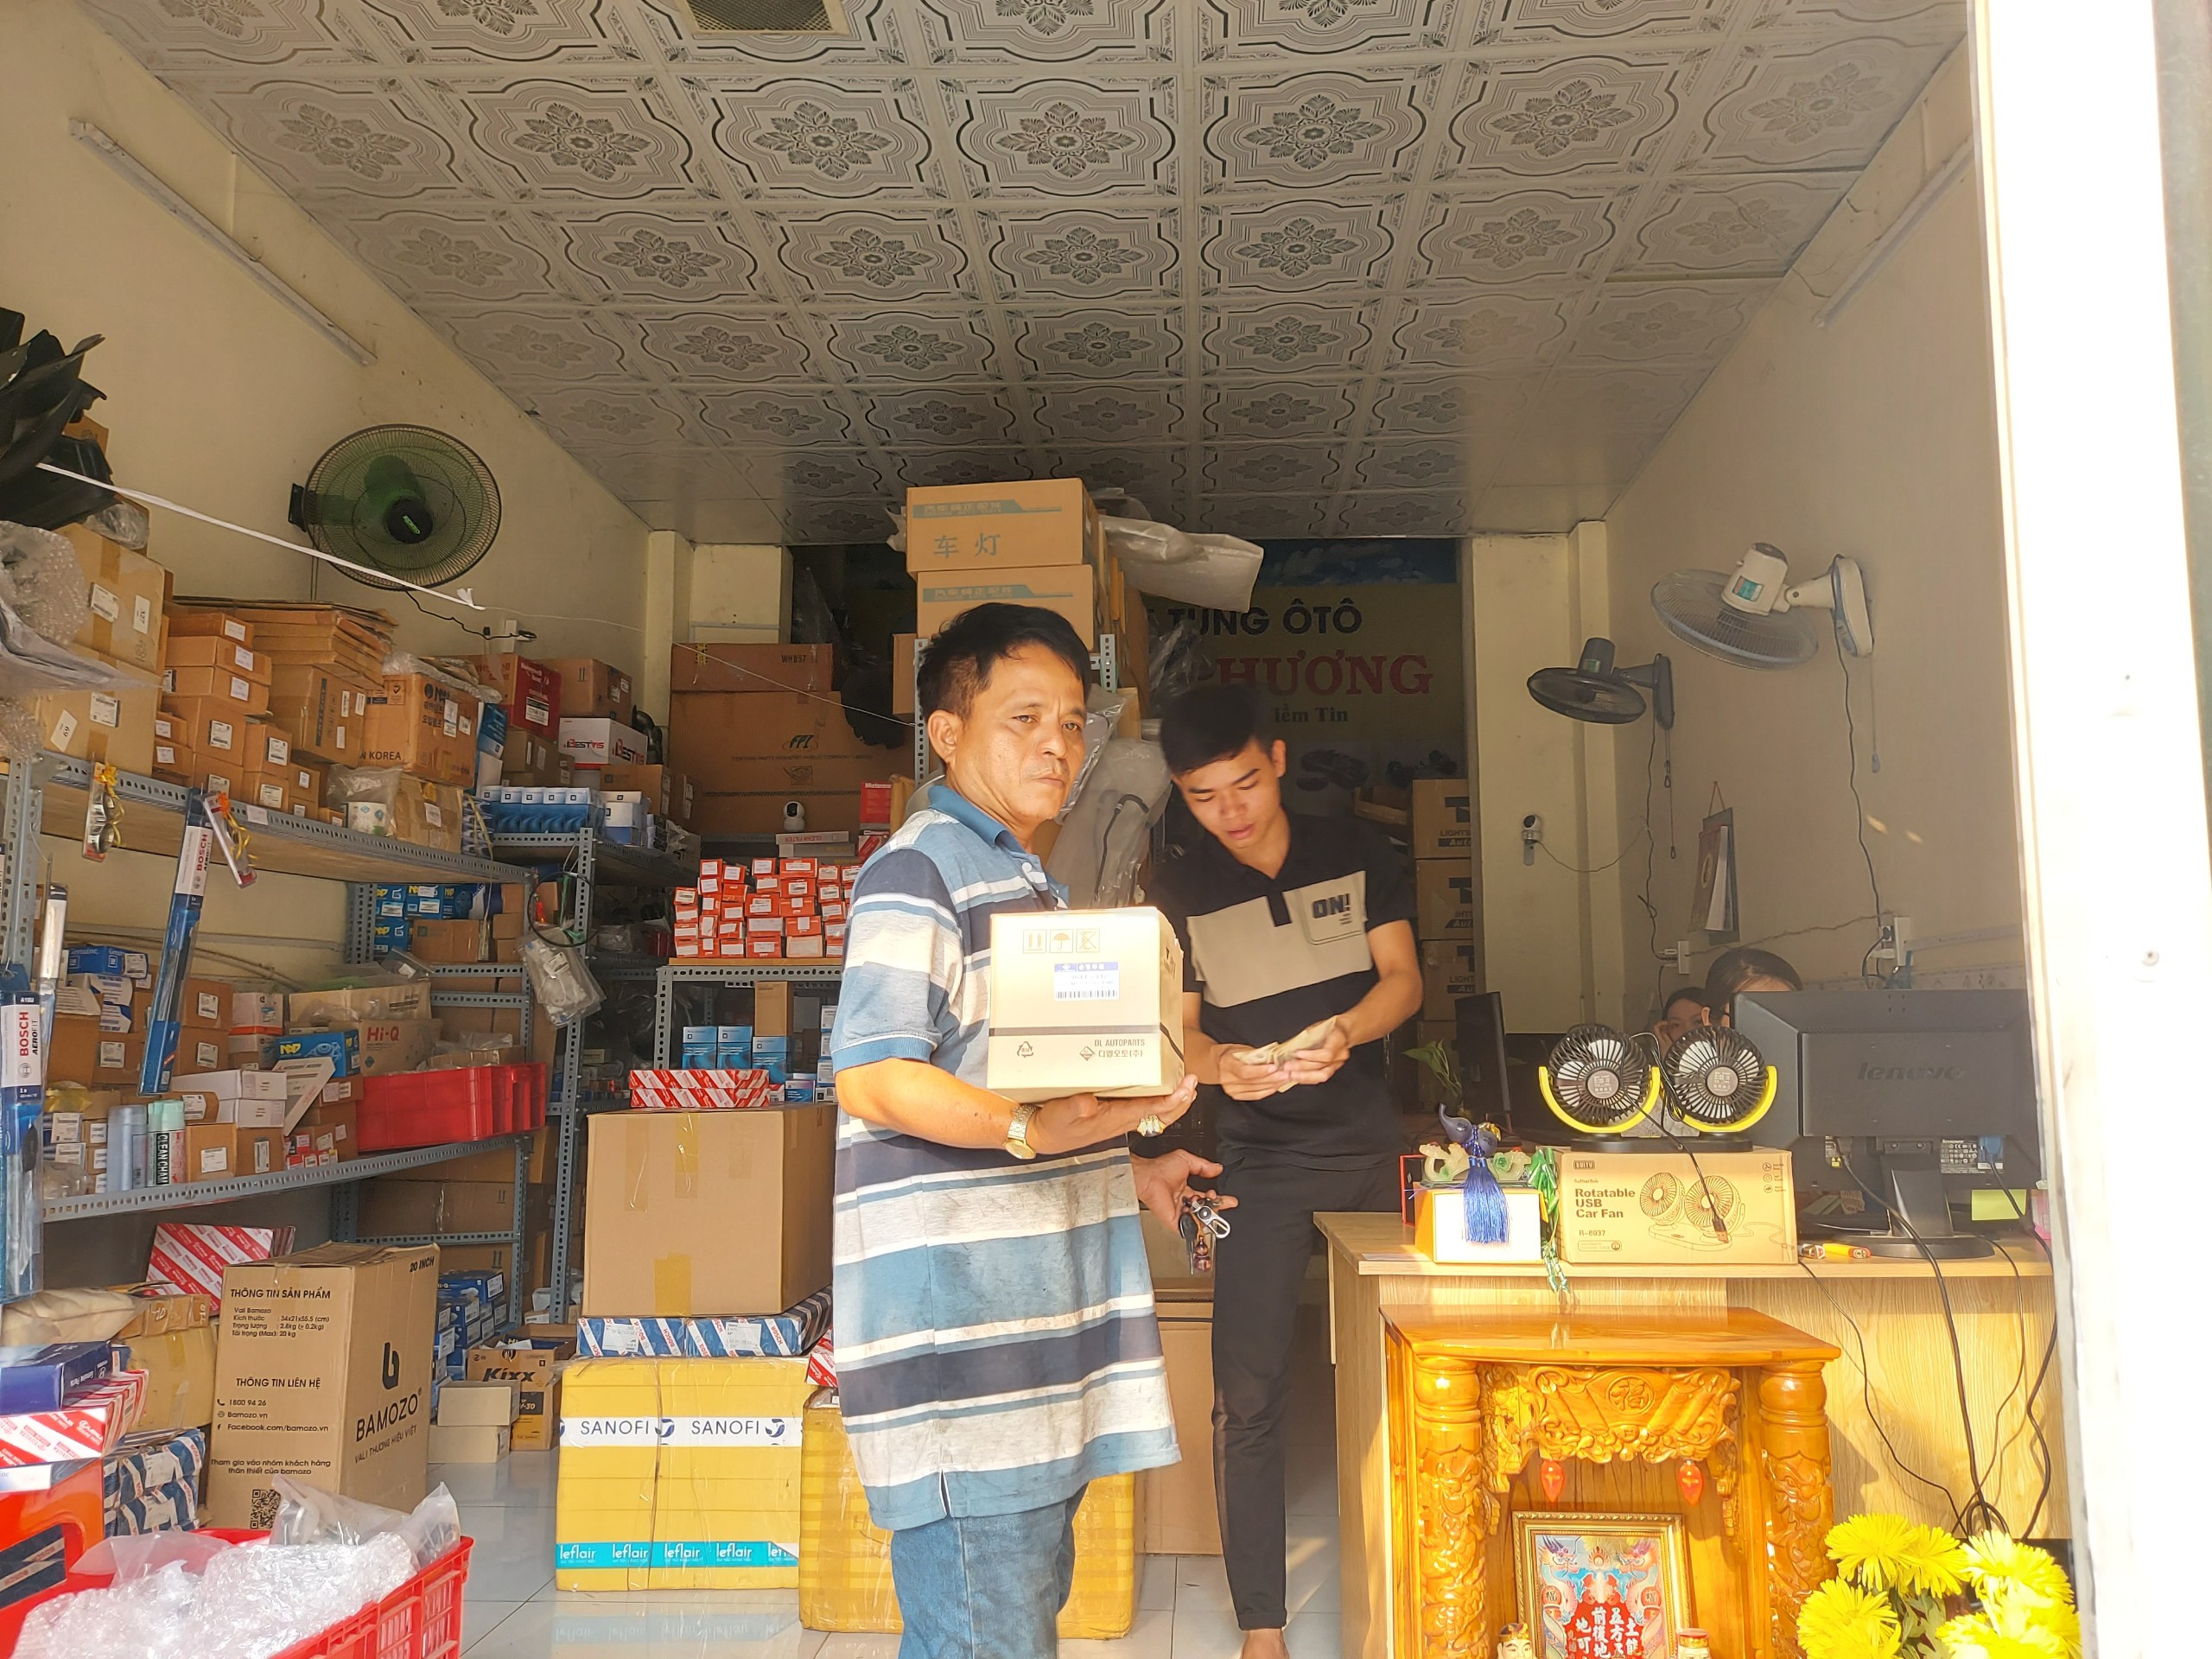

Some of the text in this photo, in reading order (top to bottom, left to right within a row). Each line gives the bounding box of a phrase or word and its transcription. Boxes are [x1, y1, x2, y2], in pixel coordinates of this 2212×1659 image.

[933, 533, 1001, 558] 车灯
[1282, 597, 1363, 635] ÔTÔ
[1215, 649, 1435, 695] HƯƠNG
[1274, 703, 1349, 723] iềm Tin
[369, 751, 402, 760] KOREA
[196, 834, 208, 871] BOSCH
[1313, 893, 1350, 918] ON!
[19, 1011, 29, 1057] BOSCH
[157, 1134, 168, 1184] CLEAN CHAM
[1575, 1188, 1636, 1198] Rotatable
[1575, 1198, 1602, 1208] USB
[1576, 1209, 1624, 1218] Car Fan
[409, 1255, 435, 1274] 20 INCH
[231, 1287, 331, 1299] THÔNG TIN SẢN PHẨM
[771, 1325, 783, 1344] BOSCH
[236, 1376, 321, 1389] THÔNG TIN LIÊN HỆ
[482, 1368, 536, 1382] Kixx
[356, 1393, 418, 1442] BAMOZO
[581, 1420, 649, 1435] SANOFI
[690, 1420, 760, 1435] SANOFI
[20, 1429, 40, 1448] TOYOTA
[355, 1450, 368, 1464] VALI
[560, 1544, 596, 1560] leflair
[612, 1543, 649, 1559] leflair
[664, 1543, 700, 1559] leflair
[715, 1543, 753, 1559] leflair
